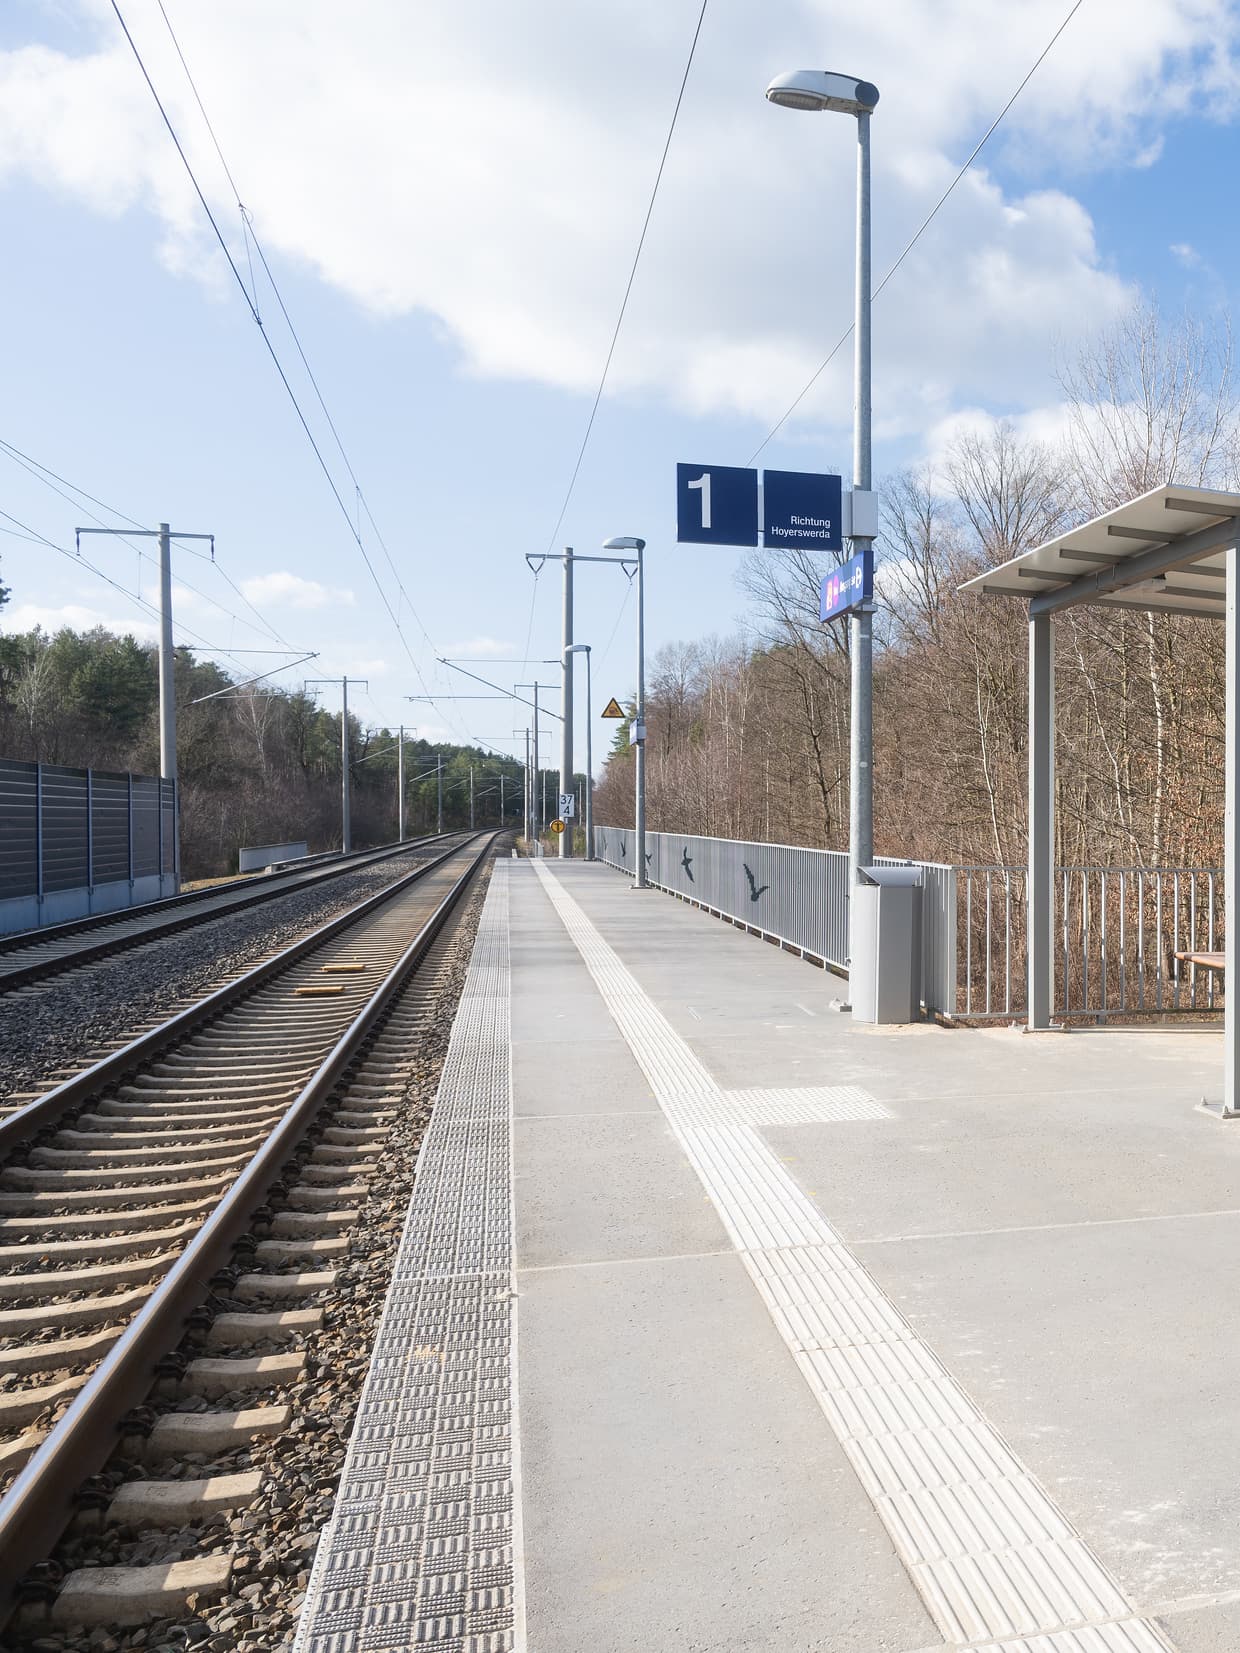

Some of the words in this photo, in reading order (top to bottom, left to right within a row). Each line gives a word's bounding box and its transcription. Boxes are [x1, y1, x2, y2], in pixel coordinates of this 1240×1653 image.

[687, 472, 712, 529] 1
[790, 515, 831, 529] Richtung
[771, 526, 831, 539] Hoyerswerda
[560, 794, 573, 805] 37
[563, 806, 570, 815] 4
